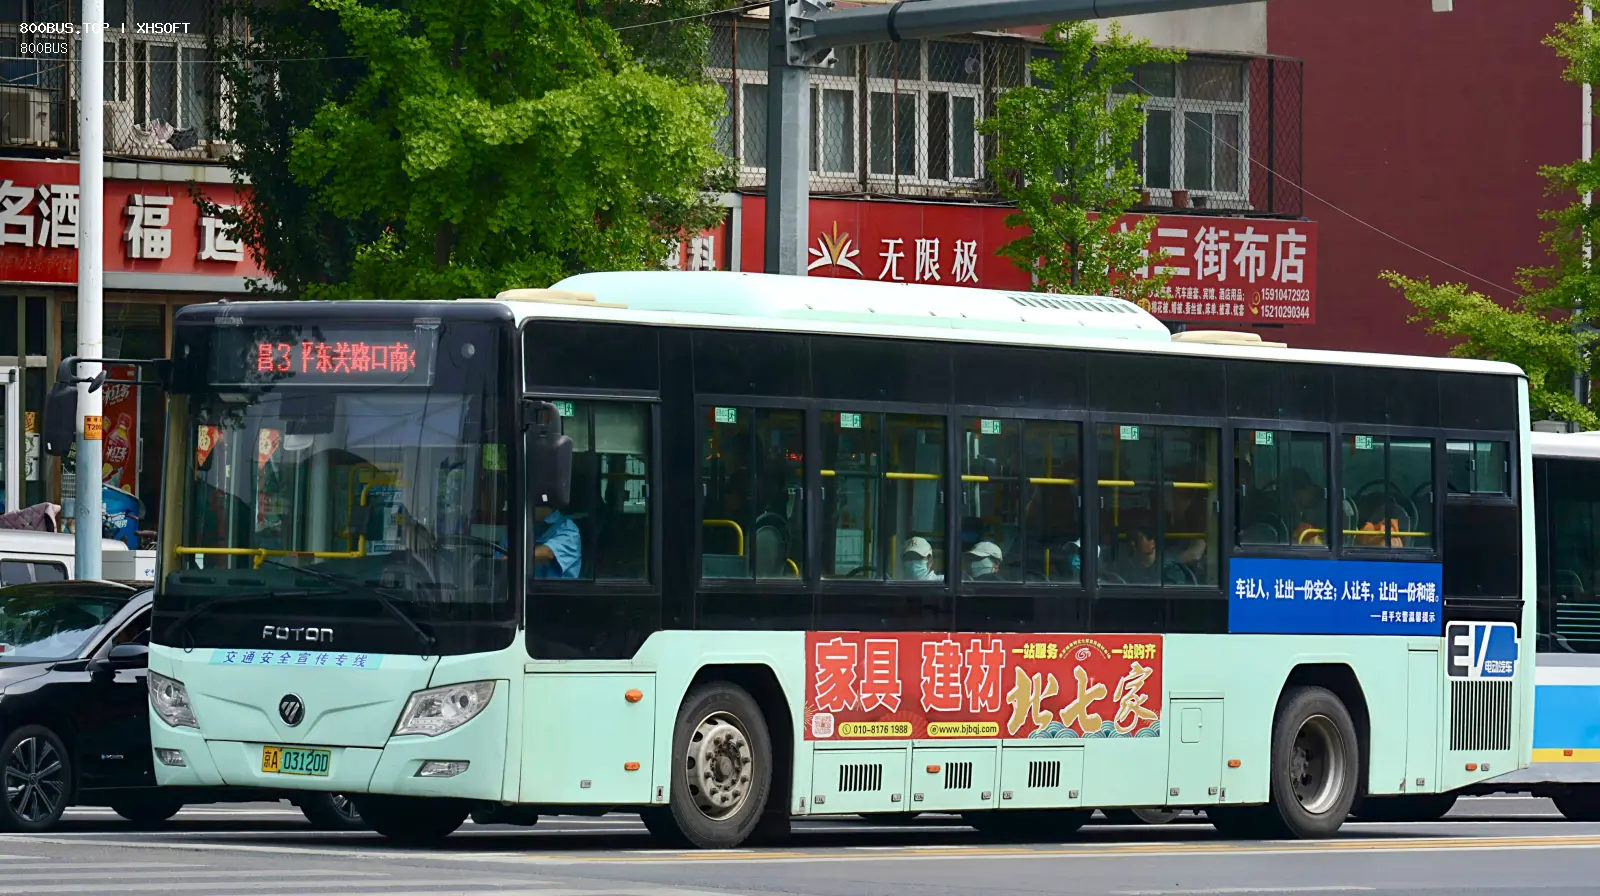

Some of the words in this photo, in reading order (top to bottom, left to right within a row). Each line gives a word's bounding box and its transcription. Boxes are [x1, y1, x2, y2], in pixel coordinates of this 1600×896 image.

[0, 180, 80, 249] 名酒
[878, 237, 979, 283] 无限极
[1261, 288, 1310, 302] 15910472923
[1261, 305, 1310, 319] 15210290344
[257, 343, 292, 372] 昌3
[262, 625, 334, 643] FOTON
[223, 650, 368, 668] 交通安全宣传专线
[1011, 643, 1059, 659] 一站服务
[1111, 643, 1156, 659] 一站购齐
[814, 637, 902, 713] 家具
[919, 638, 1007, 713] 建材
[1484, 660, 1513, 674] 电动汽车
[1006, 660, 1160, 737] 北七家
[891, 725, 908, 734] 1988
[939, 725, 997, 736] www.bjbqj.com
